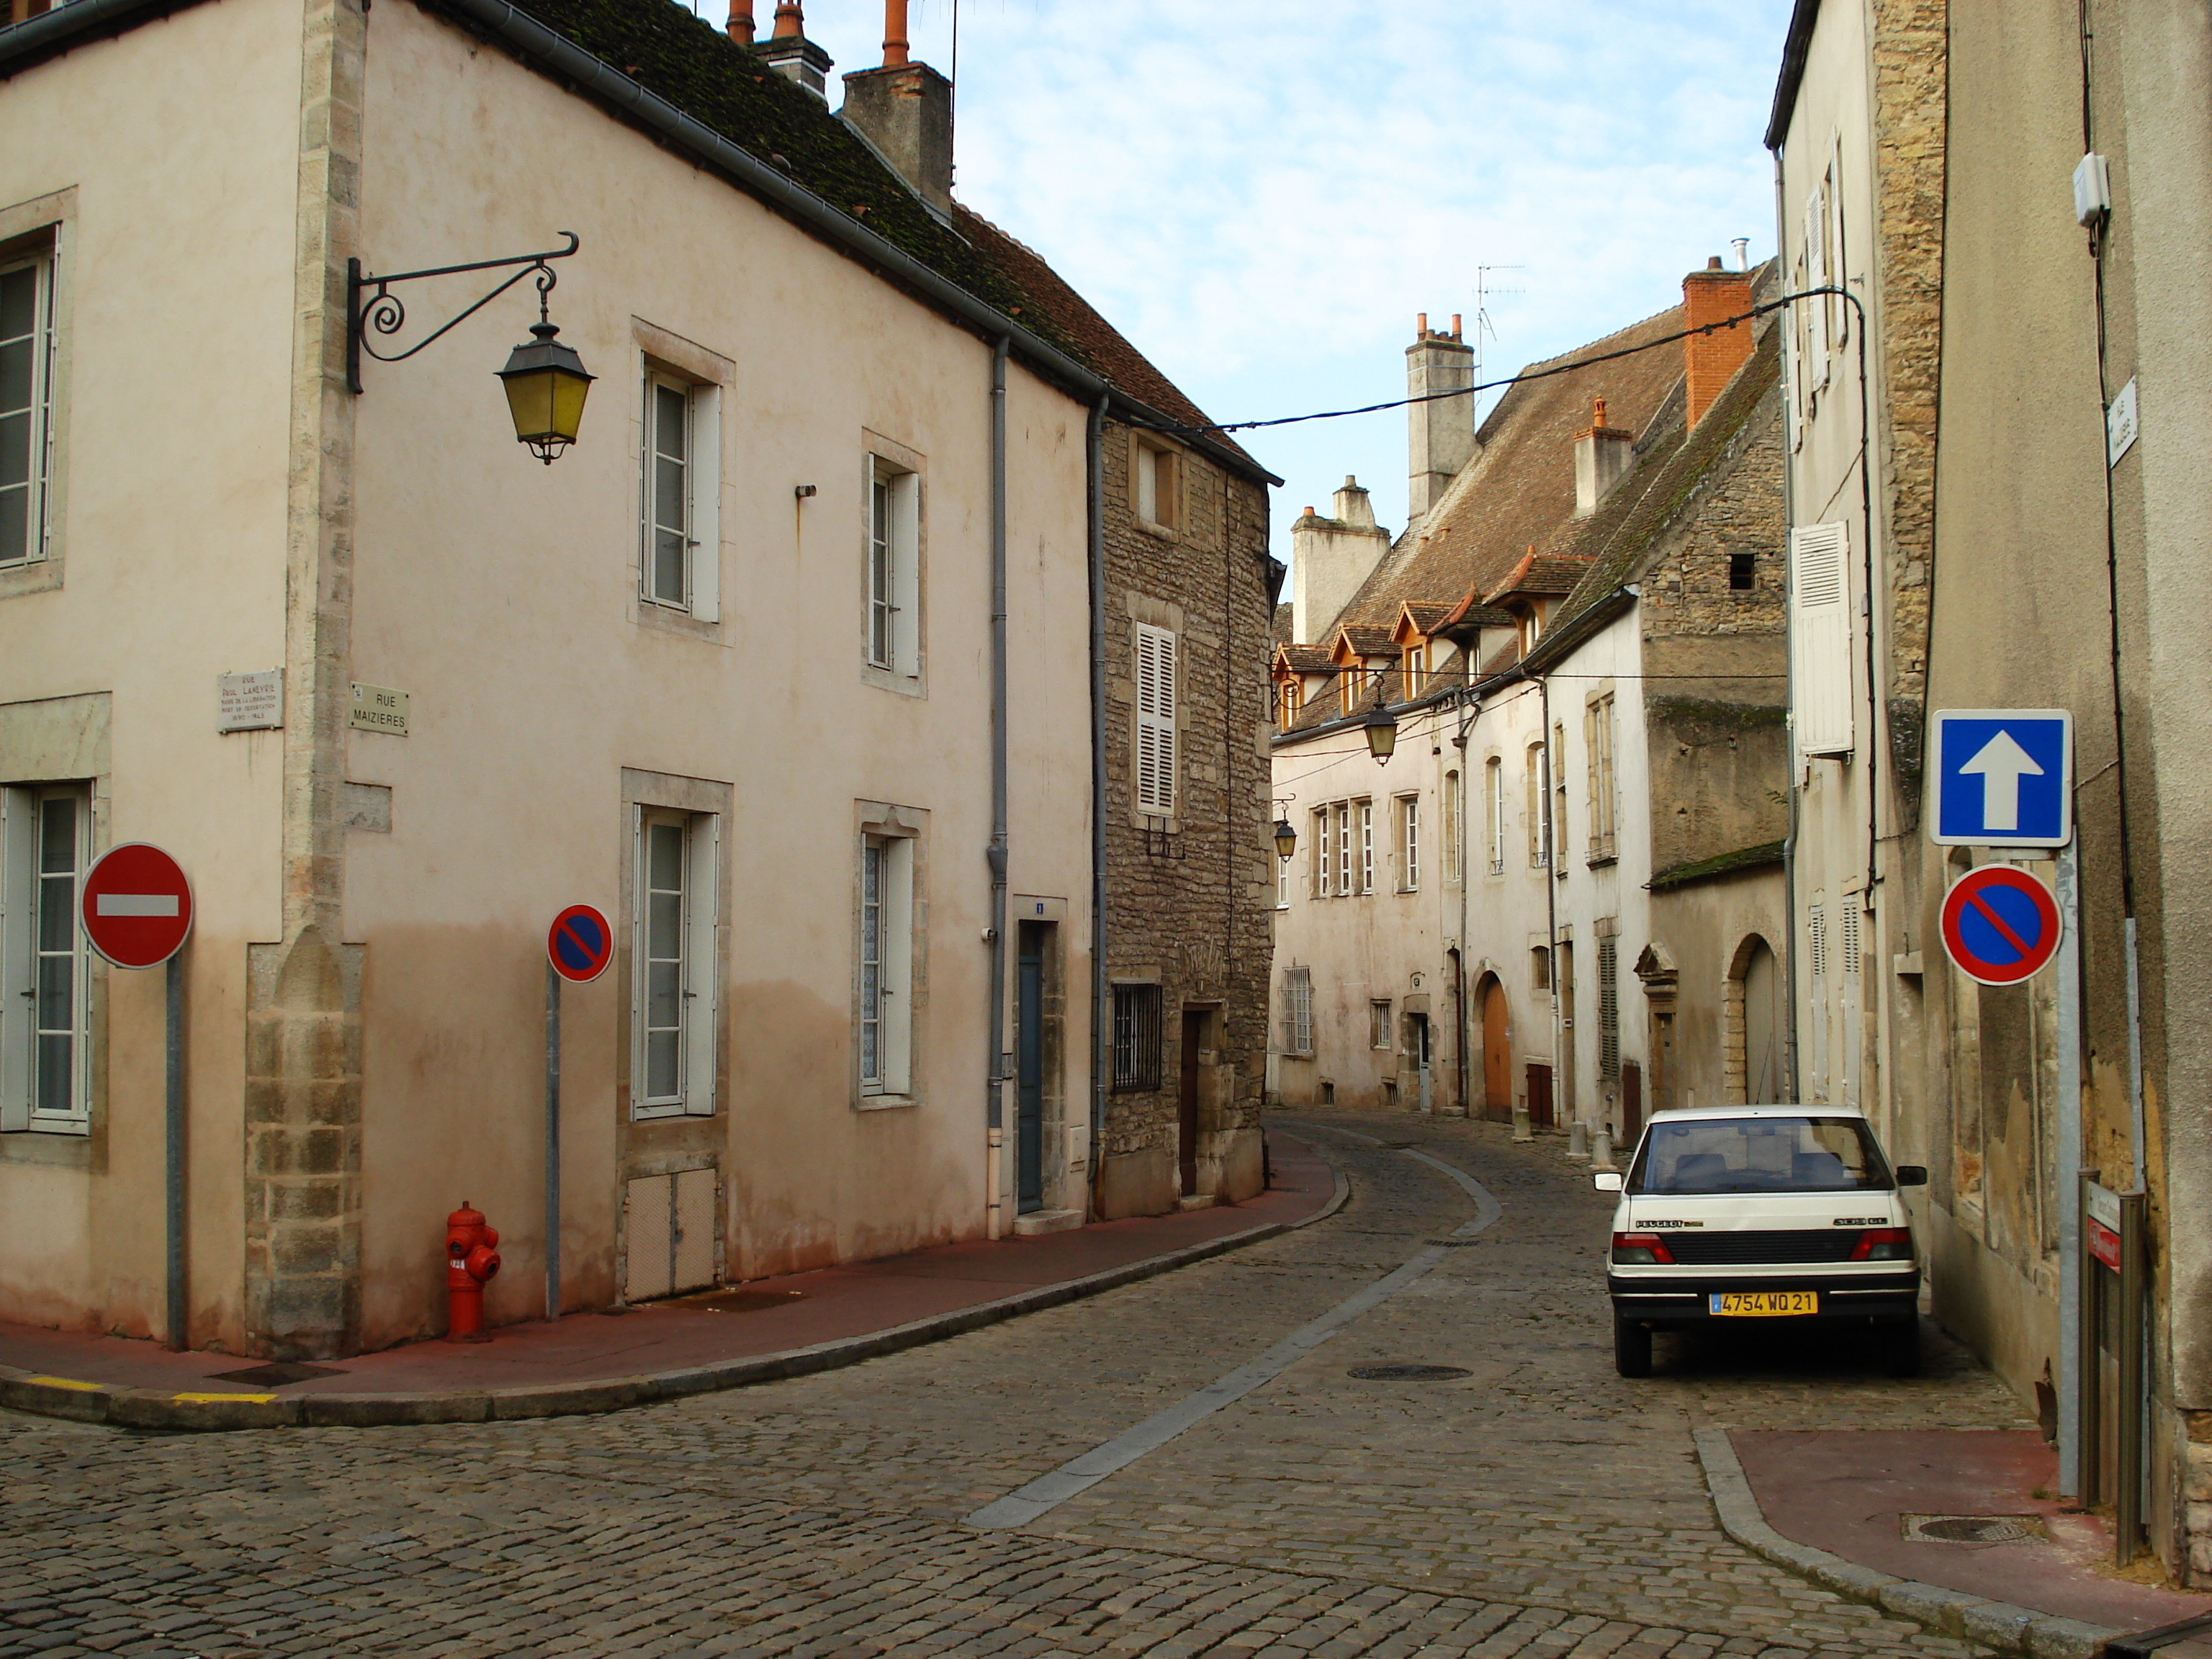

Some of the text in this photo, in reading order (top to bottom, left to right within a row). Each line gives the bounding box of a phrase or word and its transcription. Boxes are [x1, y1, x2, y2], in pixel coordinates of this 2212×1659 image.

[377, 693, 396, 707] RUE
[354, 709, 405, 727] MAIZIERES
[1722, 1295, 1763, 1311] 4754
[1793, 1294, 1811, 1310] 21
